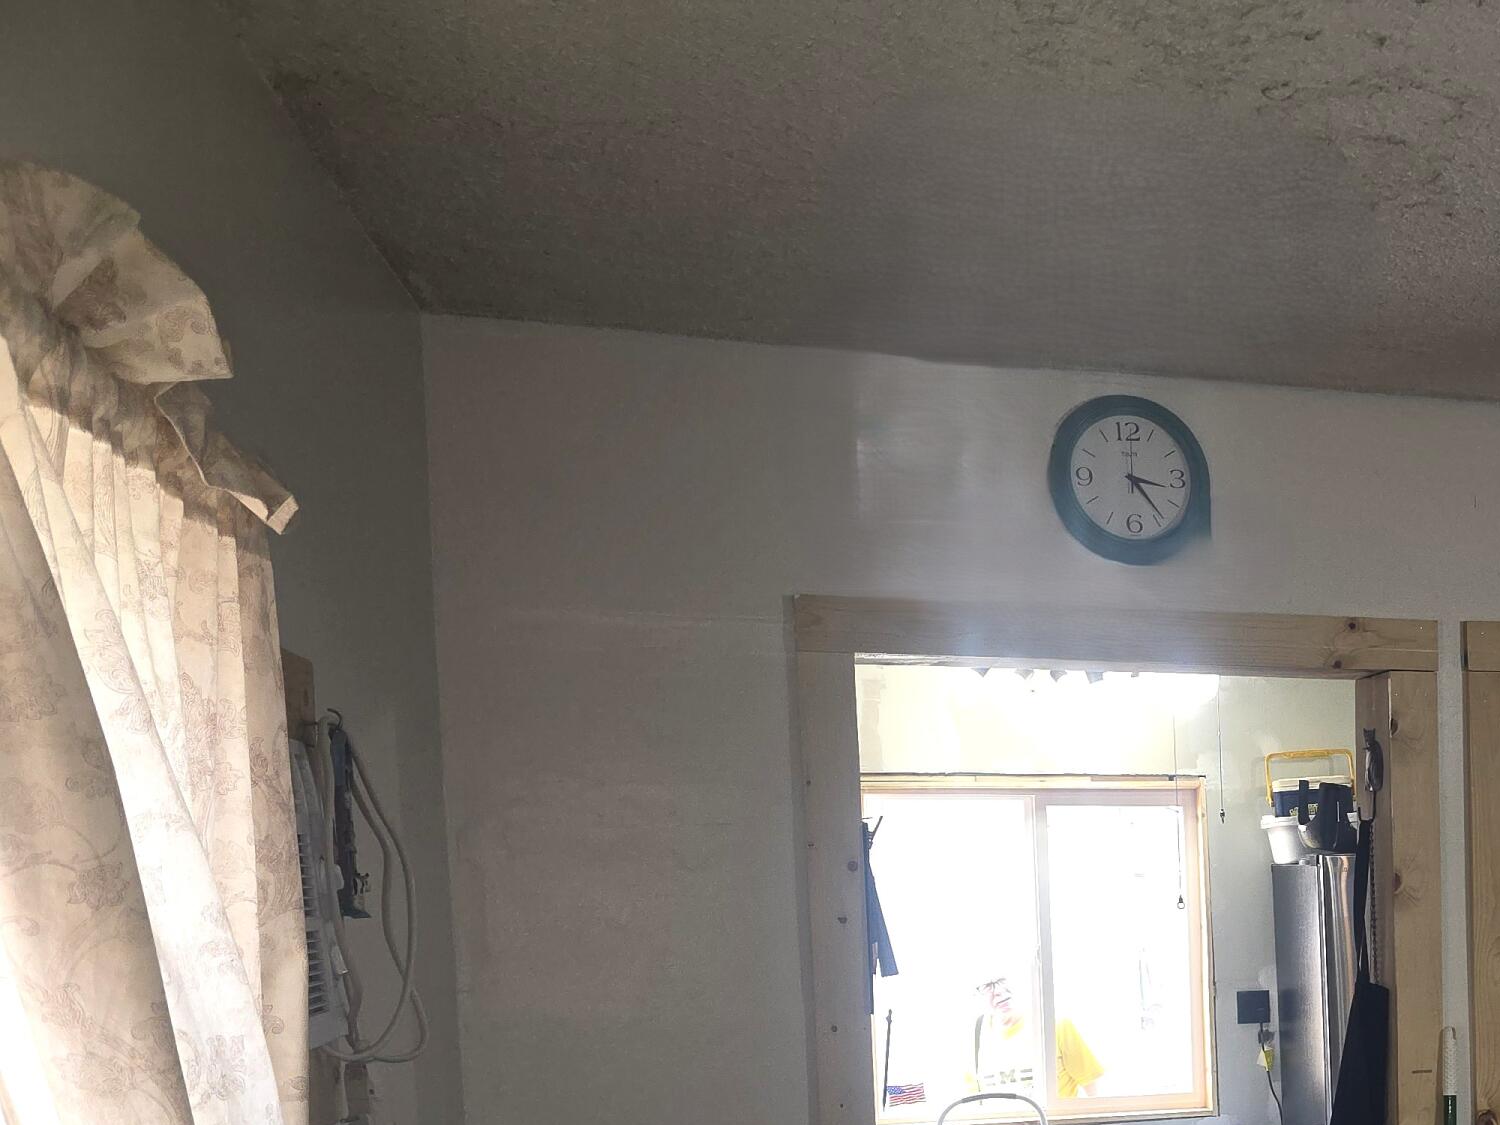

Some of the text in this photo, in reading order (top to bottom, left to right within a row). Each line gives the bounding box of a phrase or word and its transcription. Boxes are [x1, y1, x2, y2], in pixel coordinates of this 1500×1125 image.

[1115, 421, 1141, 442] 12
[1075, 466, 1093, 487] 9
[1169, 469, 1186, 489] 3
[1126, 513, 1143, 534] 6
